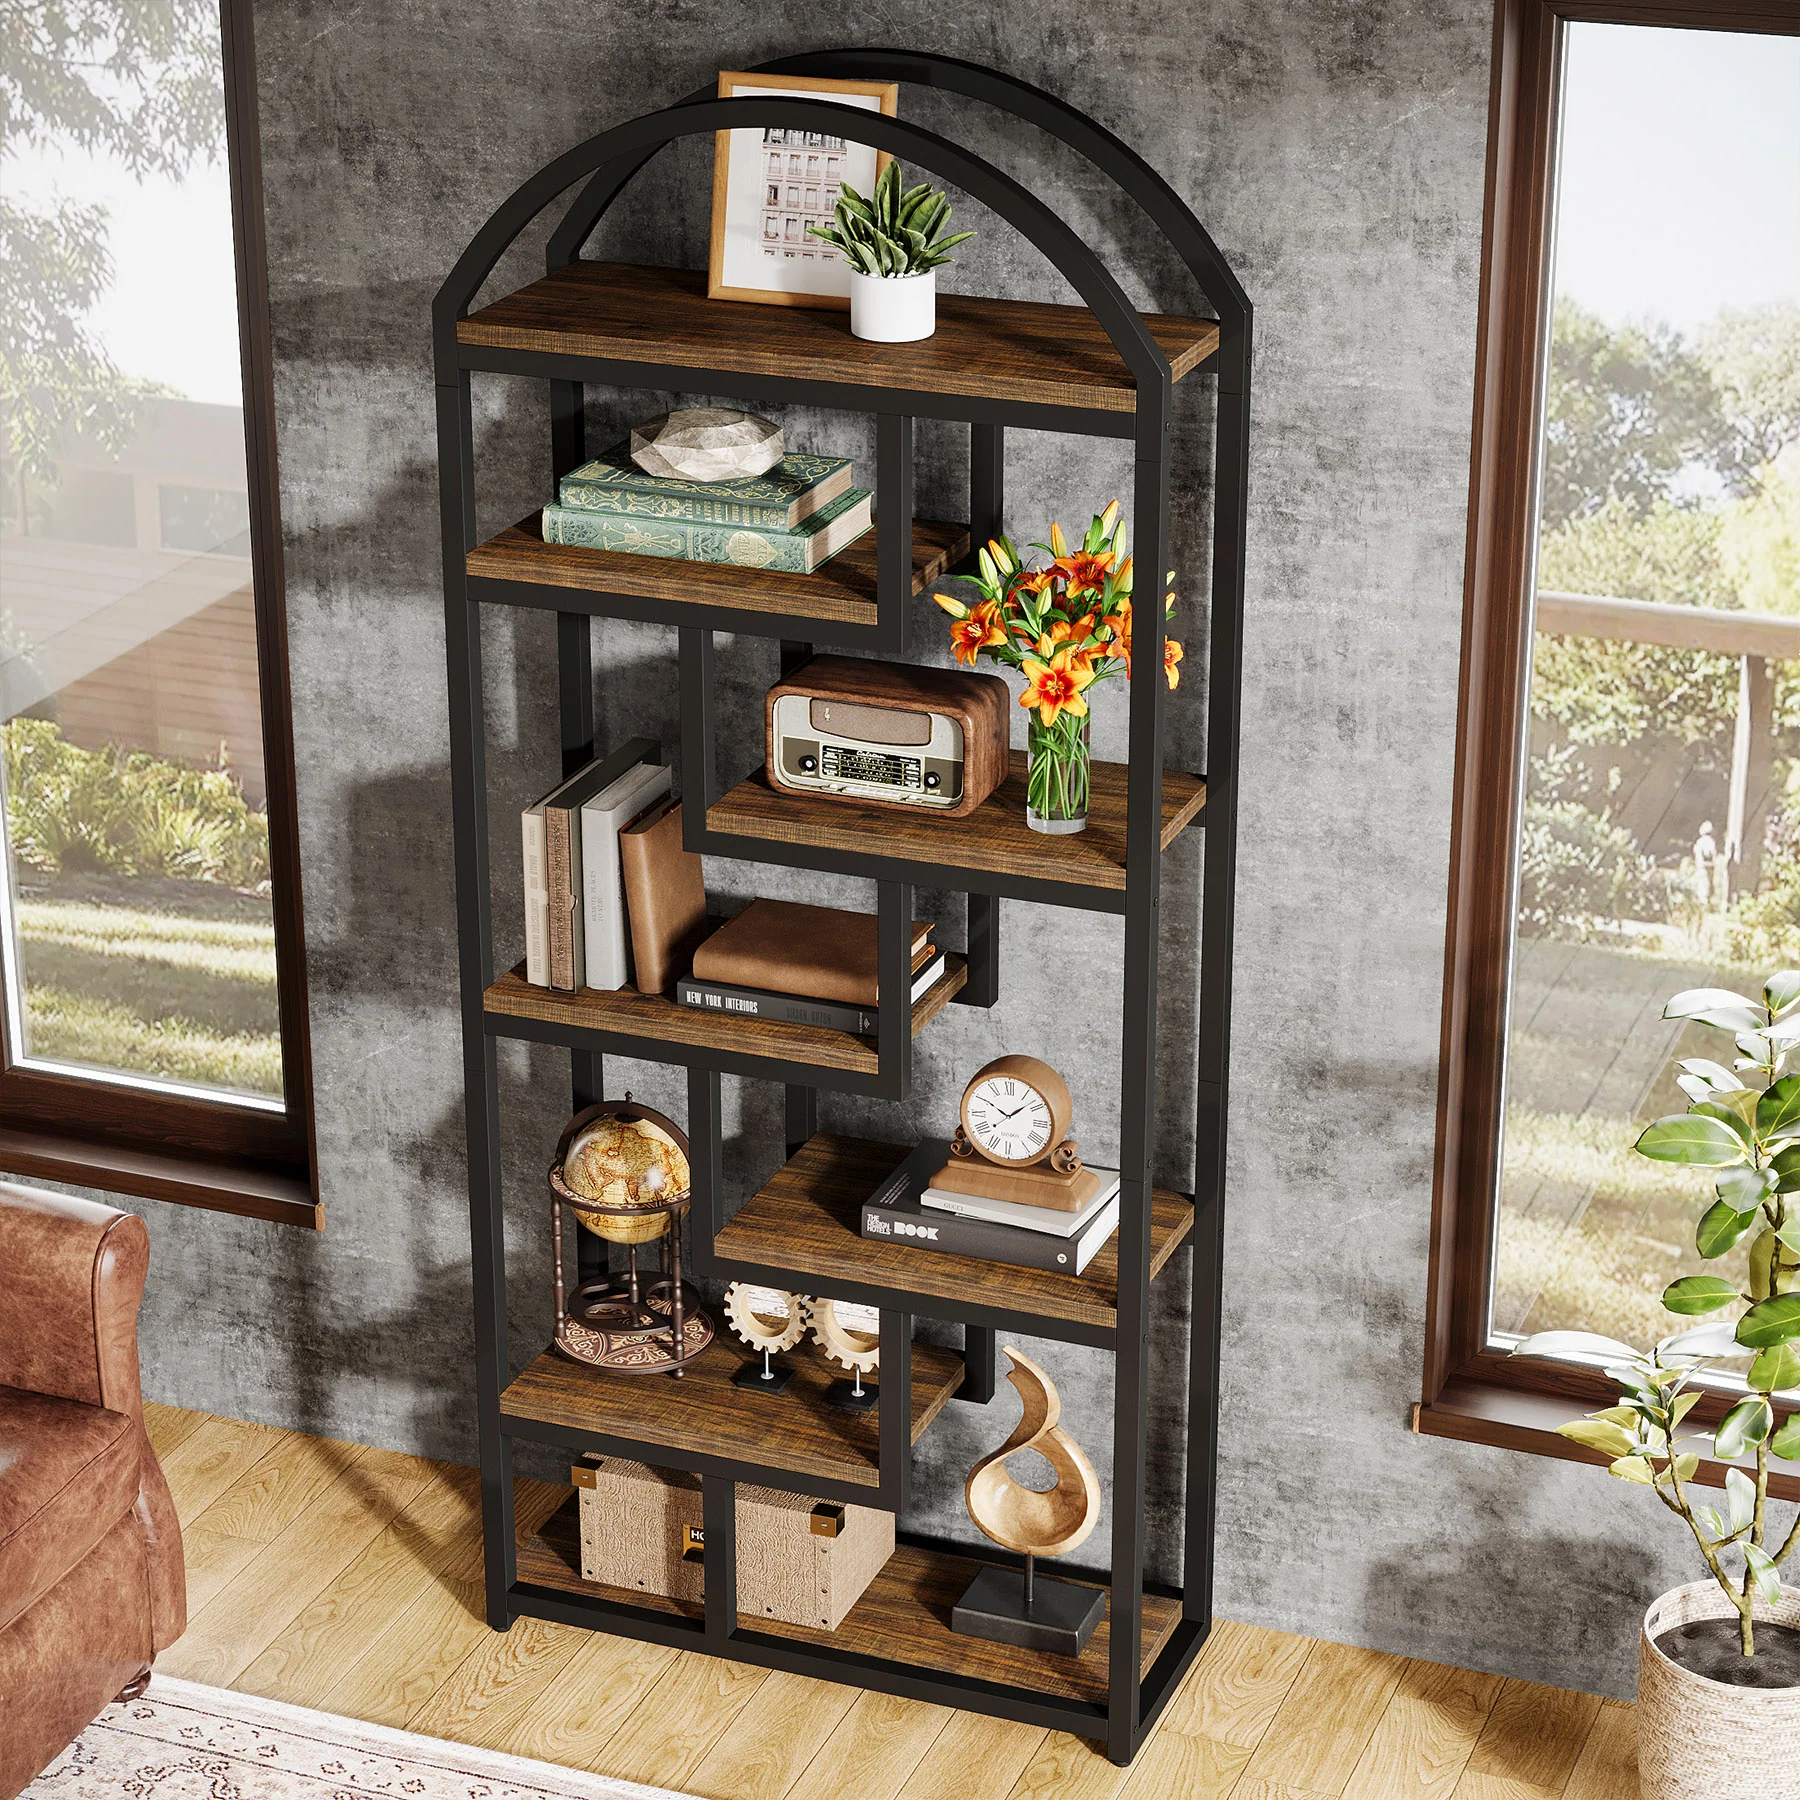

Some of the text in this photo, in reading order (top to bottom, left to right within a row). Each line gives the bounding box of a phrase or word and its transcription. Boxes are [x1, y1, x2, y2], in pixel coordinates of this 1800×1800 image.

[686, 990, 758, 1014] NEW YORK INTERIORS
[943, 1202, 964, 1212] GUCCI
[867, 1213, 880, 1221] THE
[867, 1219, 890, 1231] DESIGN
[867, 1225, 891, 1235] HOTELS
[894, 1221, 939, 1241] BOOK
